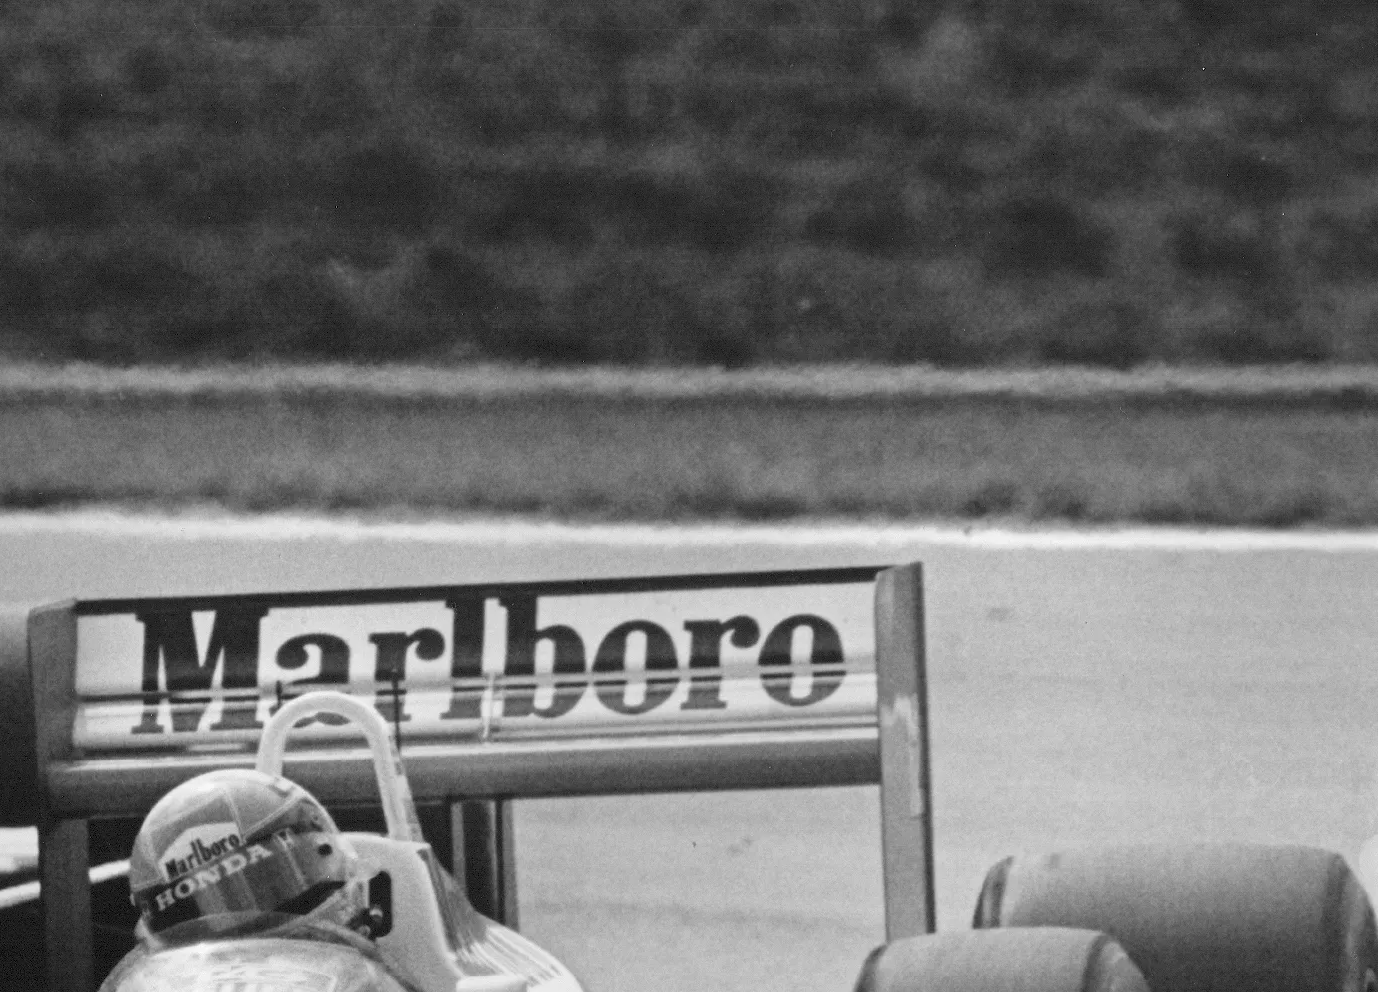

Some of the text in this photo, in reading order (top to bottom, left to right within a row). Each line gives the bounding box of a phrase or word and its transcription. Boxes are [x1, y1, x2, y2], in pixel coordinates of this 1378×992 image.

[130, 596, 847, 735] Marlboro
[155, 844, 273, 911] HONDA
[164, 833, 240, 880] Marlboro
